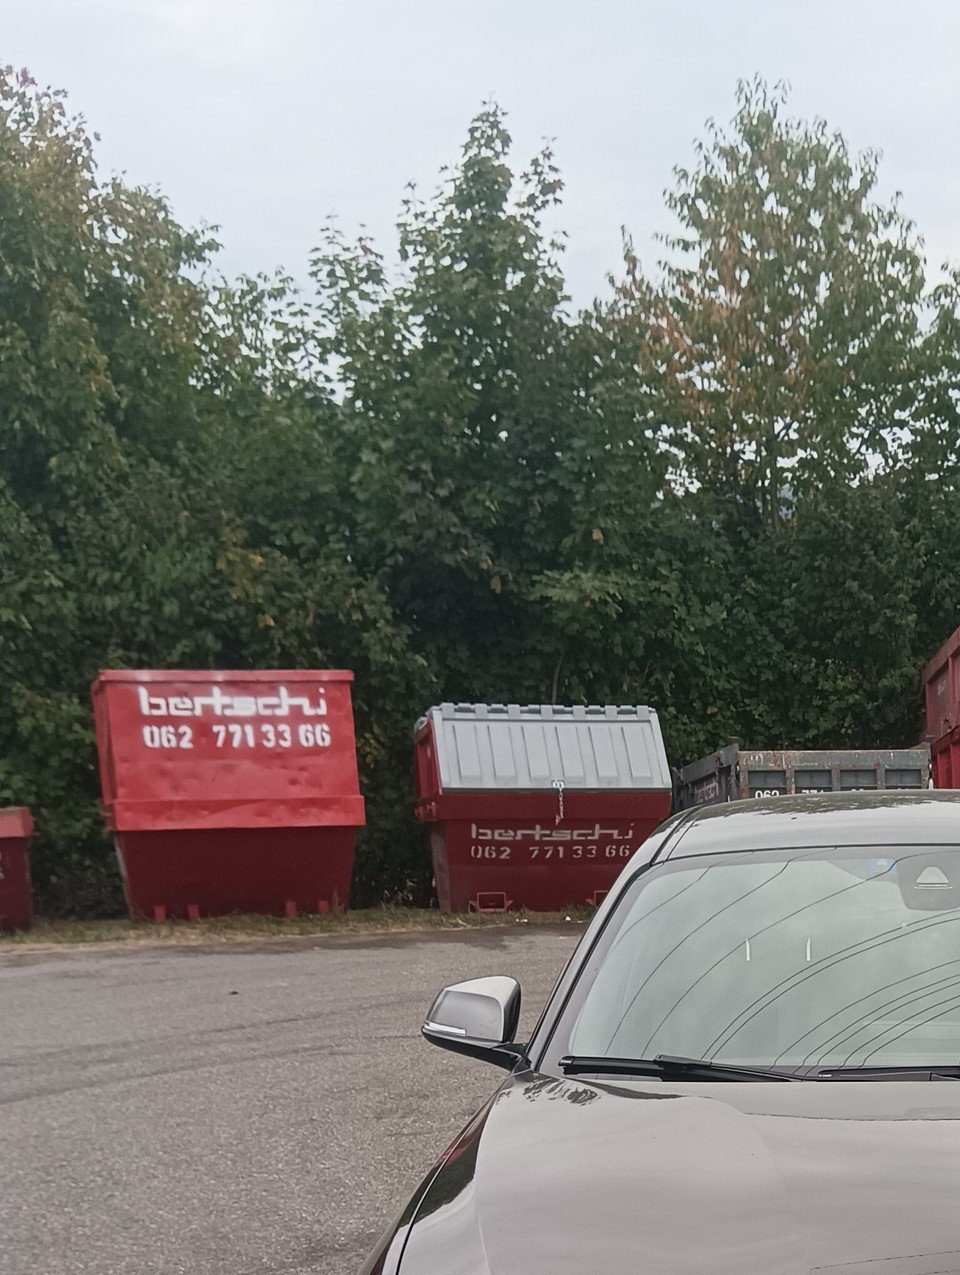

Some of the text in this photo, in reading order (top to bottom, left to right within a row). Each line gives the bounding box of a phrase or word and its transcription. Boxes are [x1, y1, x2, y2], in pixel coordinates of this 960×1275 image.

[137, 685, 328, 716] bertschi
[142, 723, 331, 749] 062 771 33 66
[471, 823, 634, 841] bertschi
[470, 844, 630, 859] 062 771 33 66
